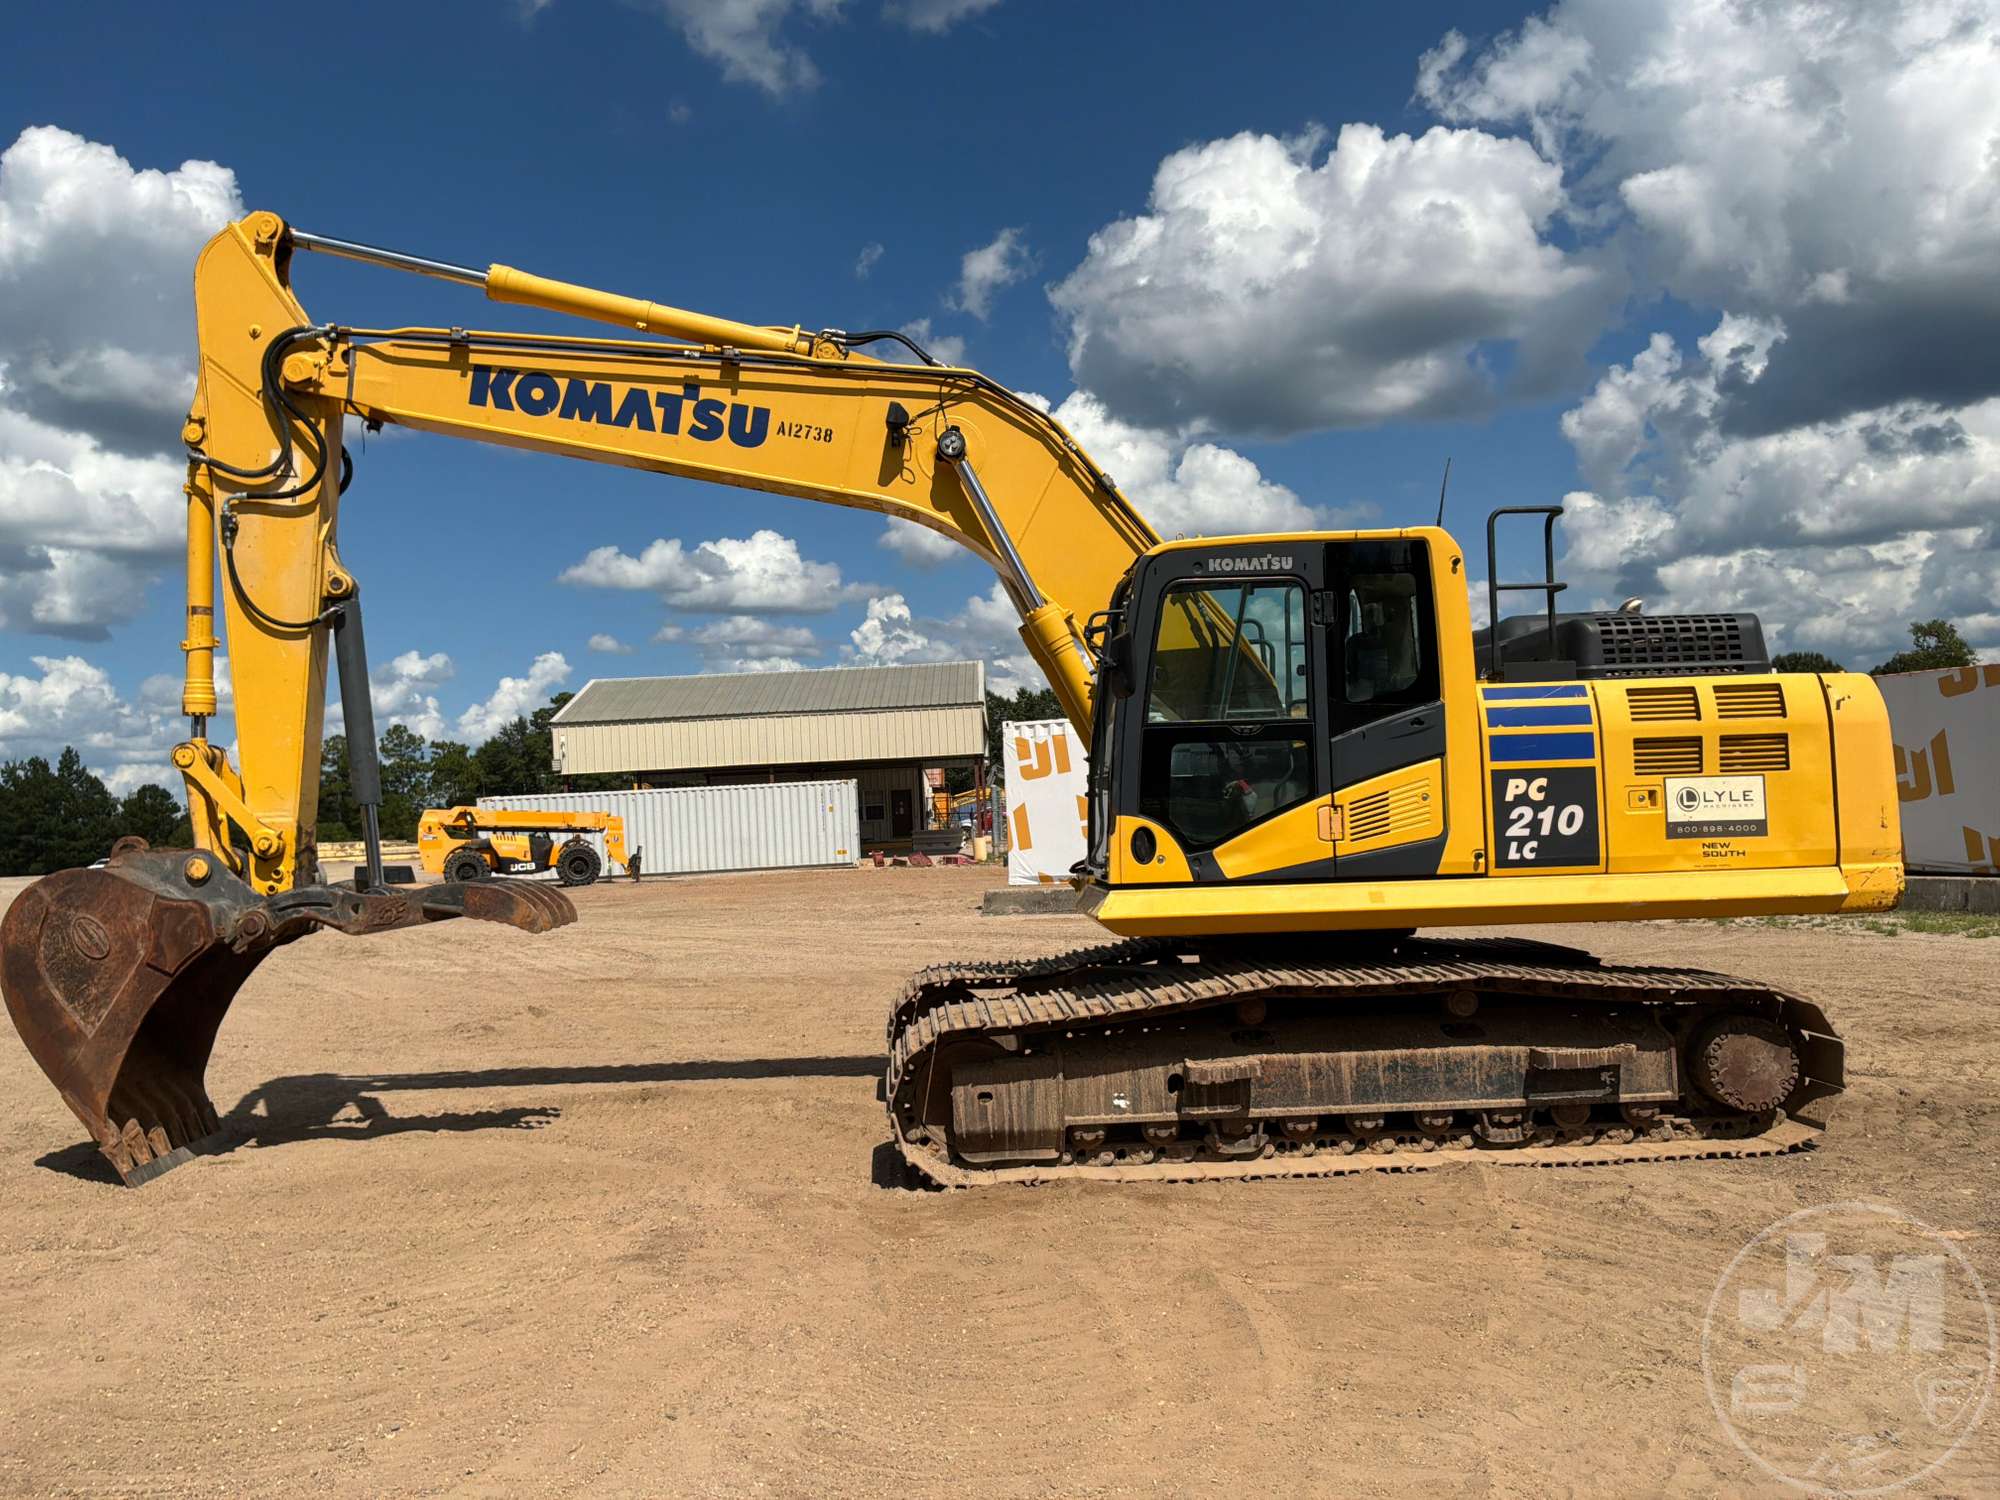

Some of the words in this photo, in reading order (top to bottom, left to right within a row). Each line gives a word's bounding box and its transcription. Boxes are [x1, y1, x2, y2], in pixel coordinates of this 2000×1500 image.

[469, 365, 770, 448] KOMATSU
[776, 421, 833, 443] A12738
[1208, 553, 1293, 572] KOMATSU
[1505, 777, 1548, 802] PC
[1703, 790, 1754, 802] LYLE
[1505, 804, 1584, 837] 210
[1507, 840, 1538, 860] LC
[510, 862, 536, 872] JCB
